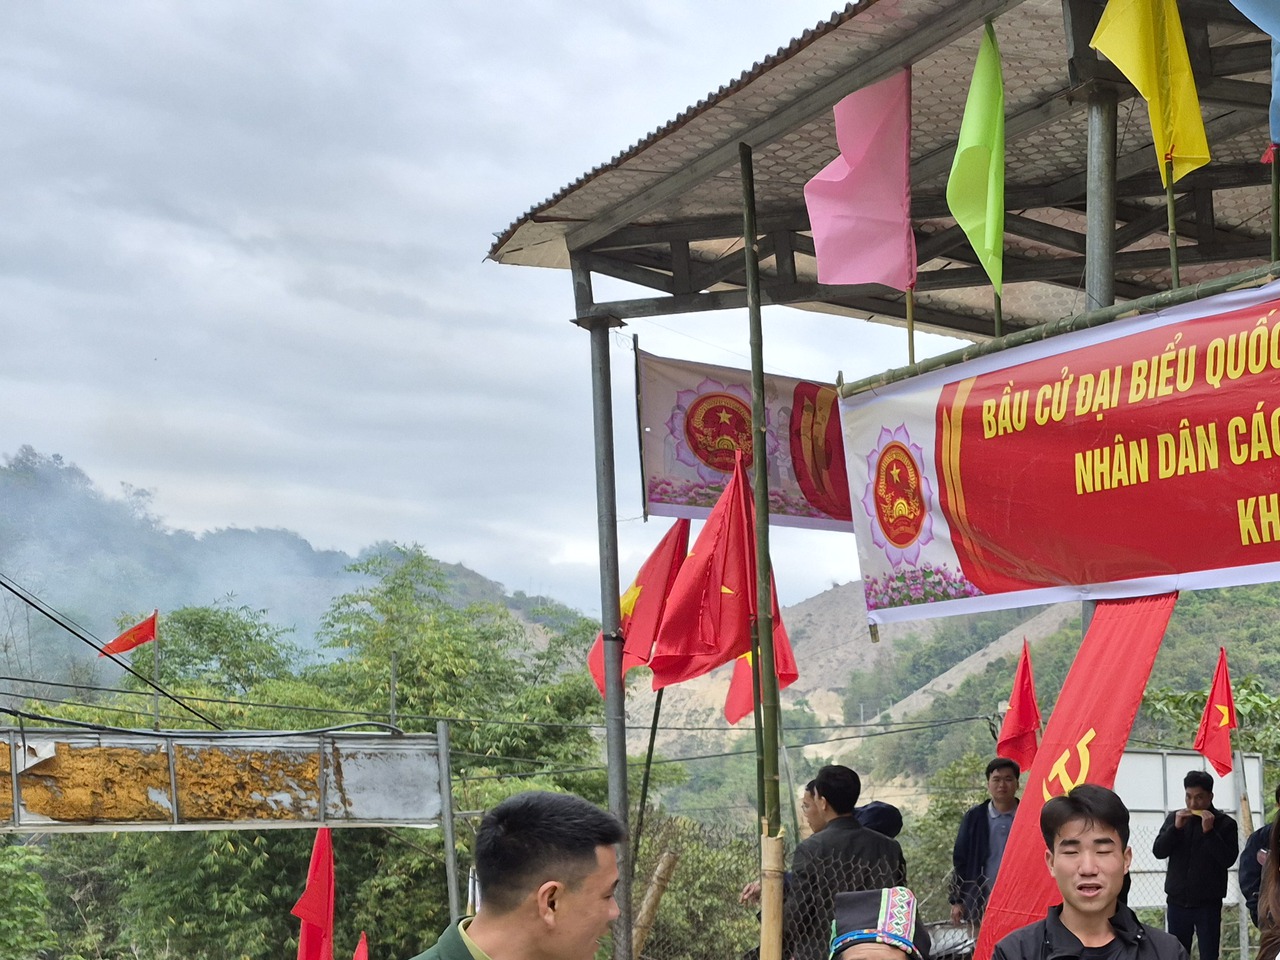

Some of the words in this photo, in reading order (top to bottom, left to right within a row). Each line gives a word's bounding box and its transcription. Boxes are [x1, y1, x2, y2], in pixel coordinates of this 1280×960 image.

[982, 379, 1030, 440] BẦU
[1034, 366, 1074, 427] CỬ
[1075, 365, 1123, 422] ĐẠI
[1128, 332, 1198, 405] BIỂU
[1074, 433, 1150, 495] NHÂN
[1156, 418, 1220, 480] DÂN
